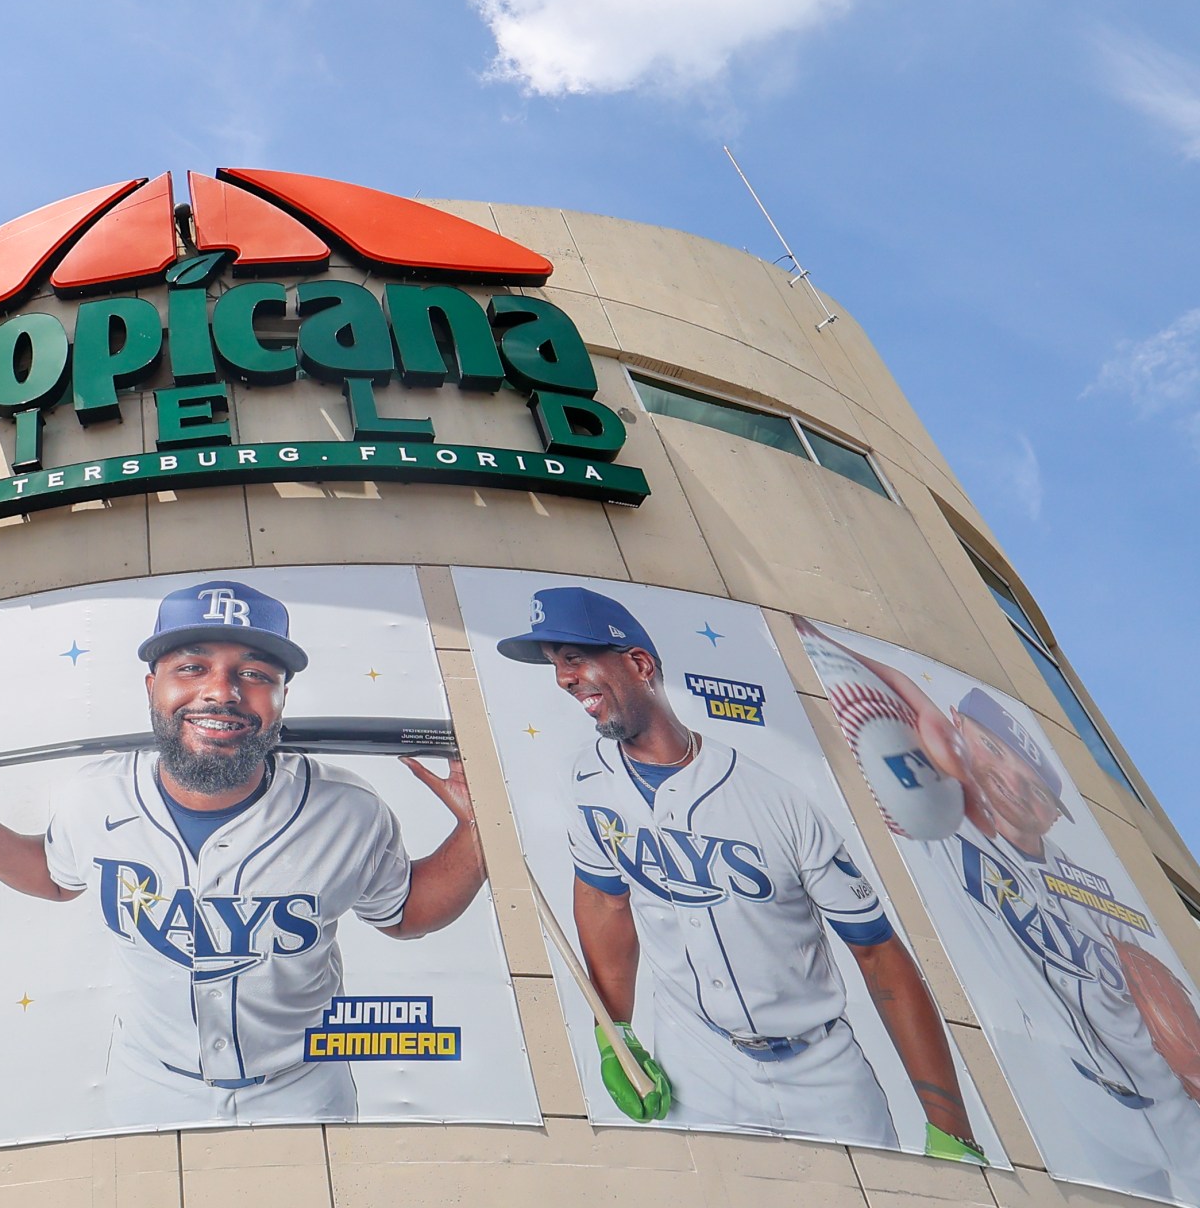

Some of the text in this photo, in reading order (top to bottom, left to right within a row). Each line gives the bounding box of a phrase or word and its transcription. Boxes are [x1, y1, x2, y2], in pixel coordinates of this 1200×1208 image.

[359, 446, 604, 482] FLORIDA
[688, 676, 762, 703] YANDY
[710, 698, 761, 723] DÍAZ
[576, 804, 777, 909] RAYS
[1061, 862, 1113, 896] DREW
[92, 857, 323, 983] RAYS
[953, 832, 1127, 993] RAYS
[1044, 875, 1150, 934] RASMUSSEN
[328, 1001, 428, 1025] JUNIOR
[309, 1032, 456, 1056] CAMINERO
